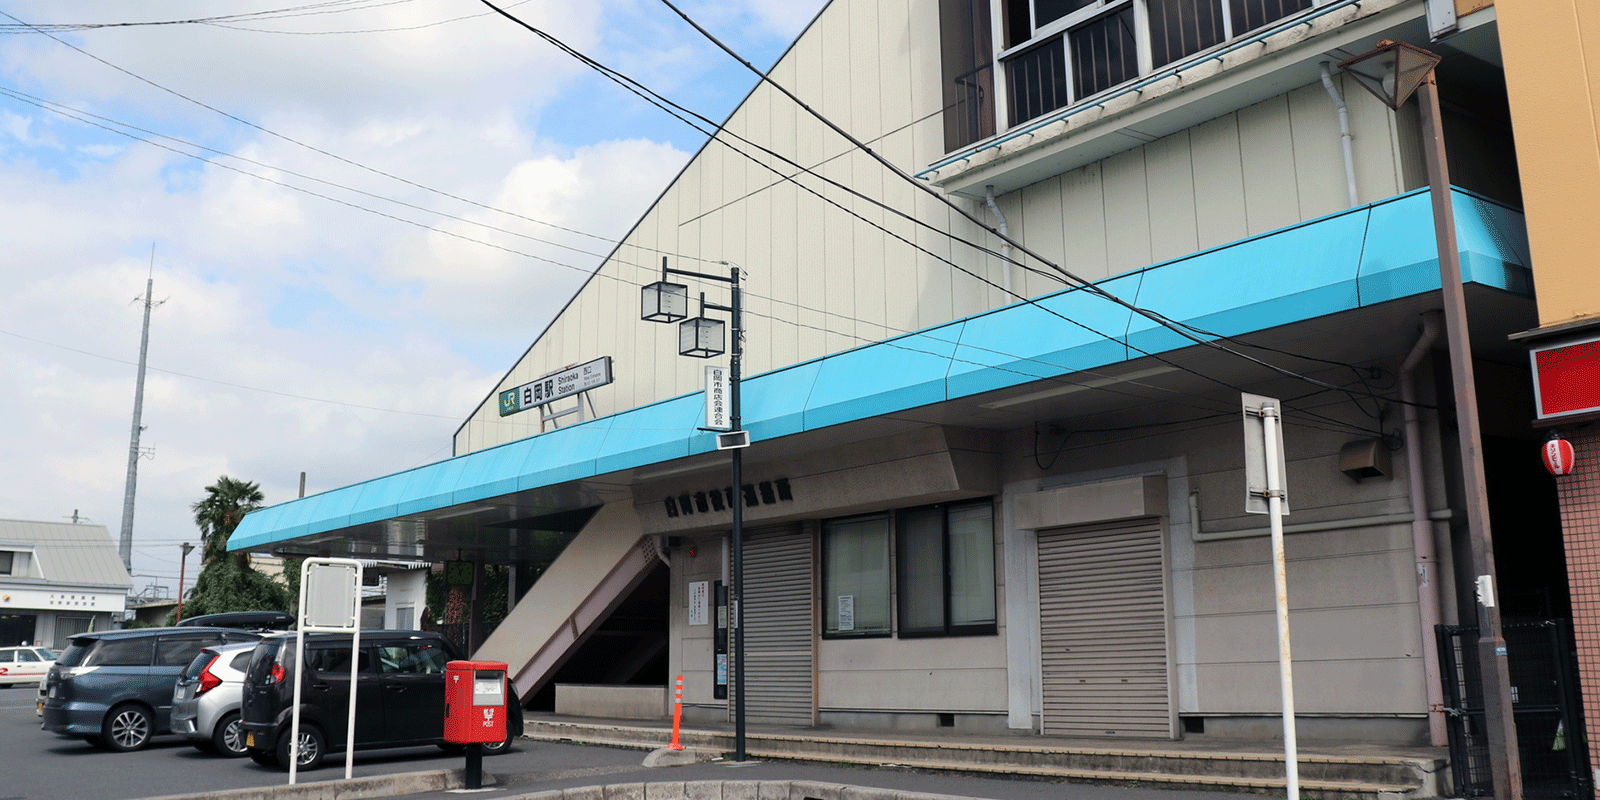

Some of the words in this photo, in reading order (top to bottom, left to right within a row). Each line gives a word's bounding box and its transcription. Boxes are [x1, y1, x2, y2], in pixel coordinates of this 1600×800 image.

[558, 371, 579, 386] Shiraoka
[523, 379, 554, 406] 白岡駅
[558, 383, 576, 395] Station
[503, 392, 516, 407] JR
